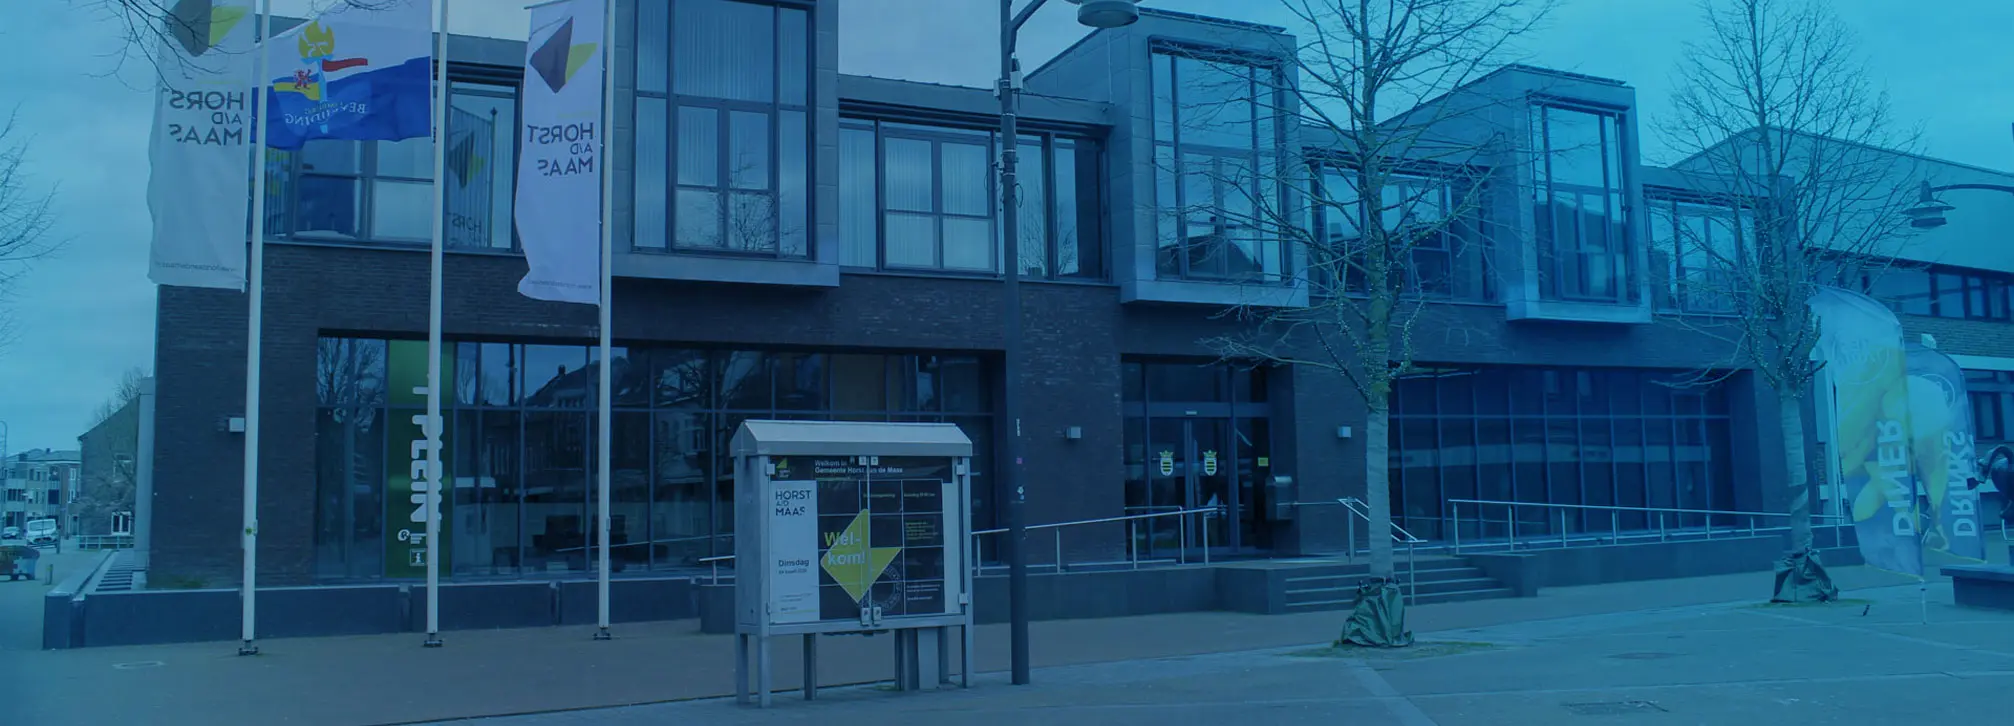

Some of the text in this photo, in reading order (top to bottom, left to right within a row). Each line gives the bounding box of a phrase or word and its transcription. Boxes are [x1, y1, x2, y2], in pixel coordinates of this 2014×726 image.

[815, 466, 846, 474] Gemeente
[848, 466, 865, 474] Horst
[887, 466, 903, 474] Maas
[775, 489, 812, 500] HORST
[775, 506, 806, 517] MAAS
[823, 531, 861, 546] Wel-
[827, 550, 866, 565] kom!
[778, 559, 810, 568] Dinsdag
